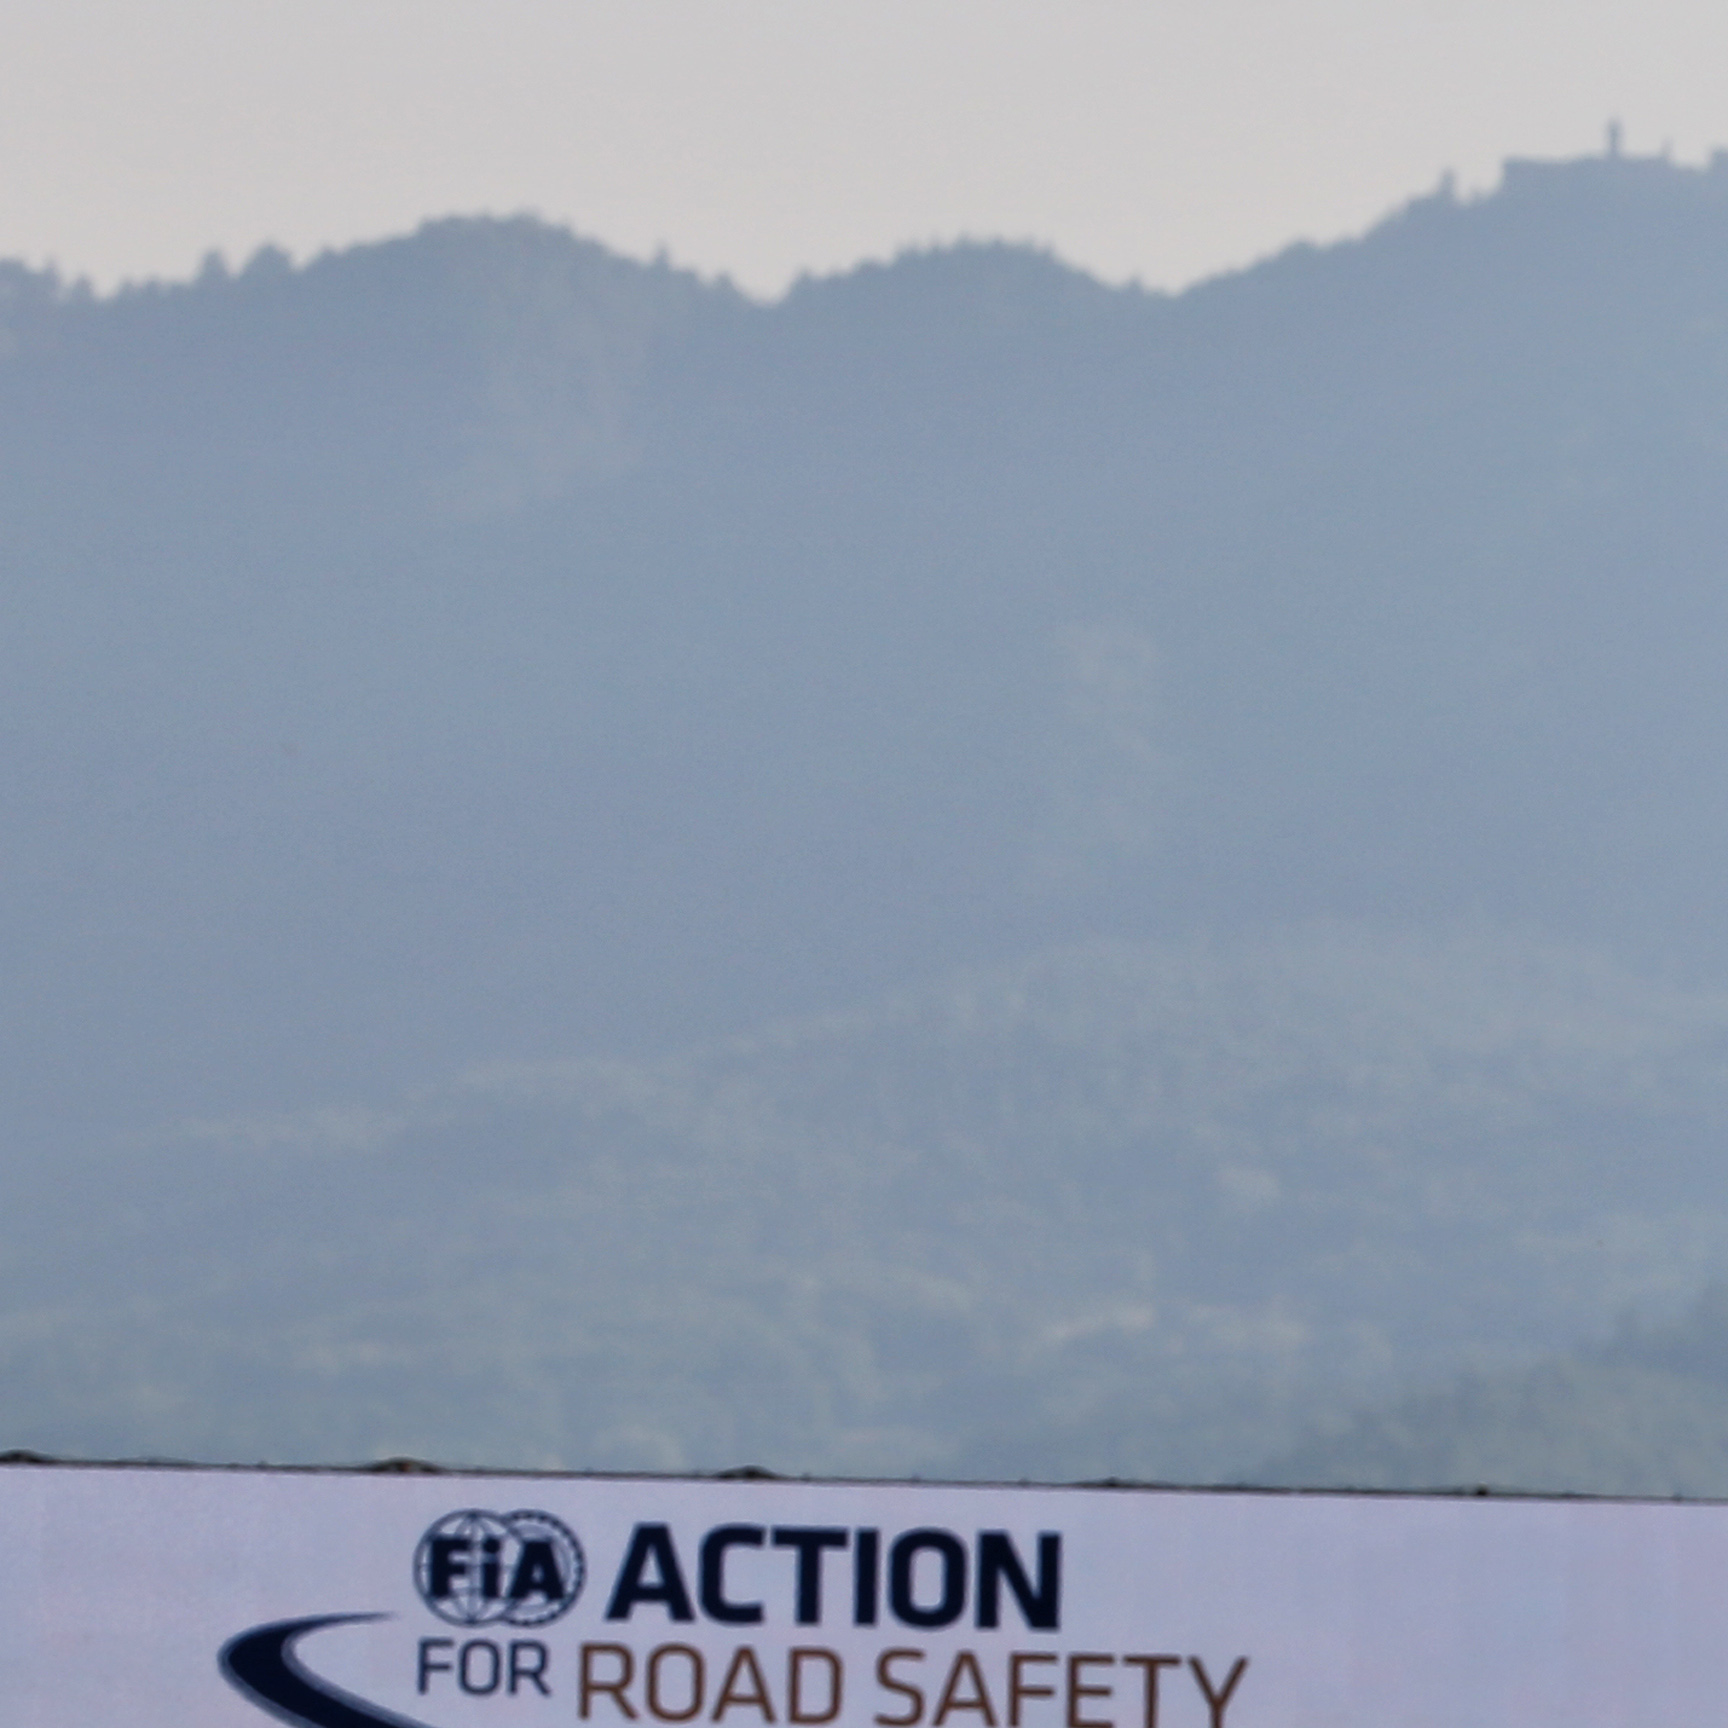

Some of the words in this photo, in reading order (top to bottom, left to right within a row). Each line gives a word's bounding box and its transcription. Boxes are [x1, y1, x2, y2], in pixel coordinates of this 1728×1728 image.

[606, 1524, 1062, 1631] ACTION
[418, 1638, 552, 1696] FOR
[578, 1643, 844, 1725] ROAD
